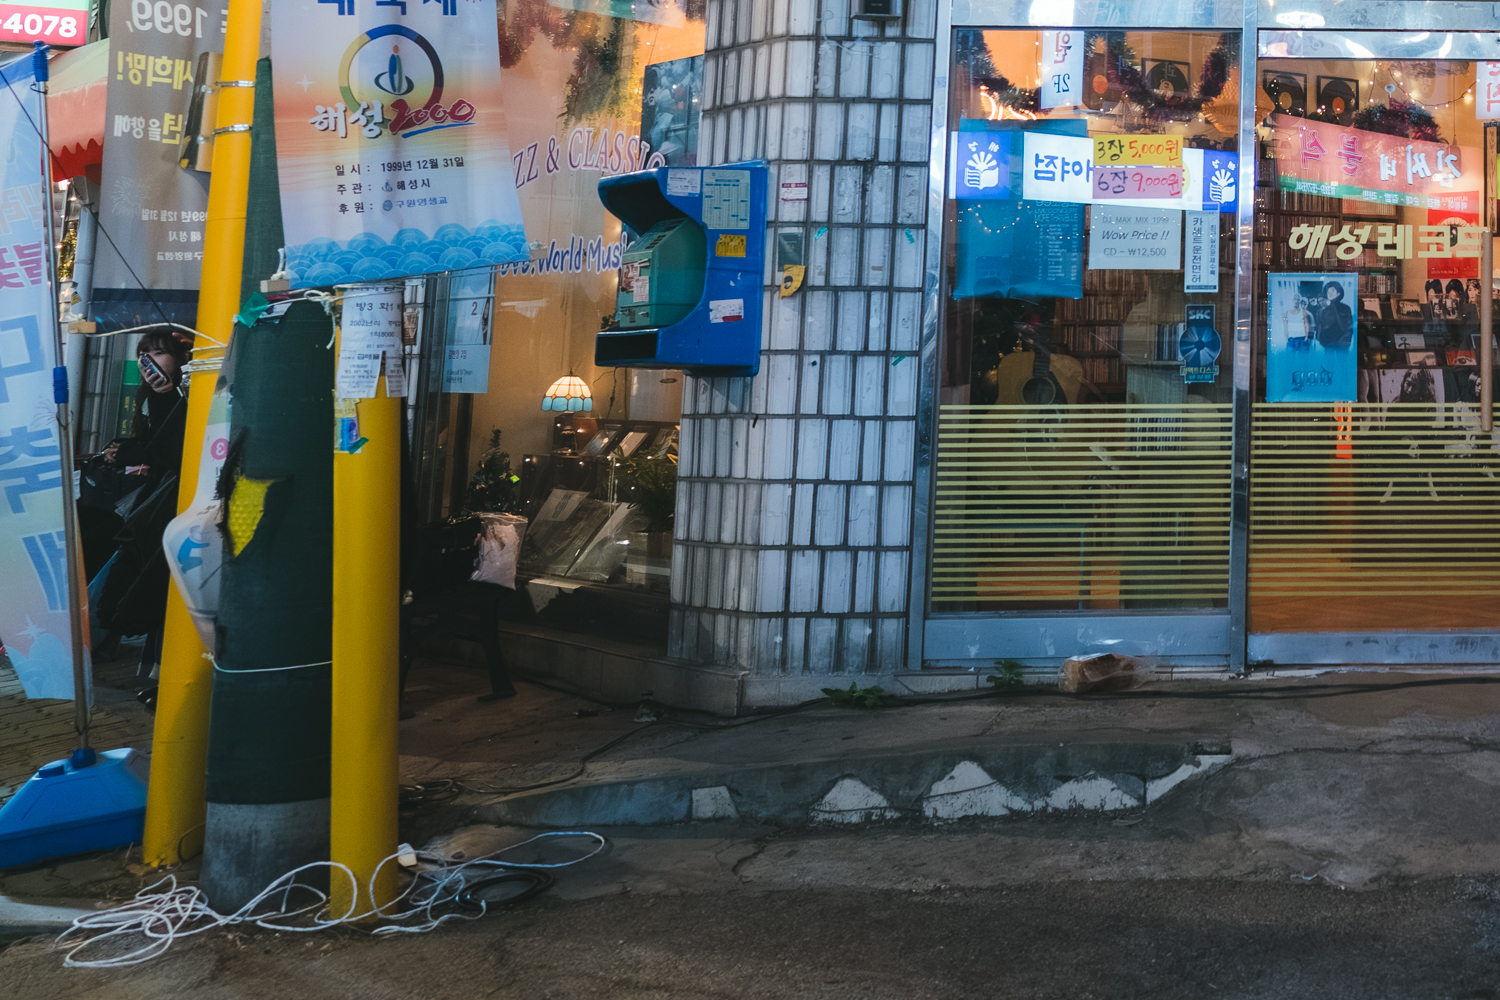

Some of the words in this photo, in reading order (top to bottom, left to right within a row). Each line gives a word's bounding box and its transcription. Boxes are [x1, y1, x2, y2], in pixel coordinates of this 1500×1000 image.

[309, 98, 384, 139] 해성
[1097, 138, 1125, 162] 3장
[1128, 138, 1180, 162] 5,000원
[380, 161, 413, 172] 1999년
[417, 158, 439, 170] 12월
[442, 156, 465, 168] 31일
[513, 141, 539, 190] ZZ
[545, 136, 560, 174] &
[396, 178, 431, 191] 해성시
[1097, 170, 1129, 195] 6장
[1131, 171, 1181, 197] 9,000원
[1102, 216, 1112, 224] DJ
[1115, 216, 1132, 224] MAX
[1135, 216, 1149, 224] MIX
[1152, 216, 1169, 224] 1999
[1101, 230, 1129, 240] Wow
[1131, 230, 1158, 240] Price
[586, 232, 636, 274] Musi
[1103, 247, 1117, 256] CD
[1188, 309, 1211, 320] SKC
